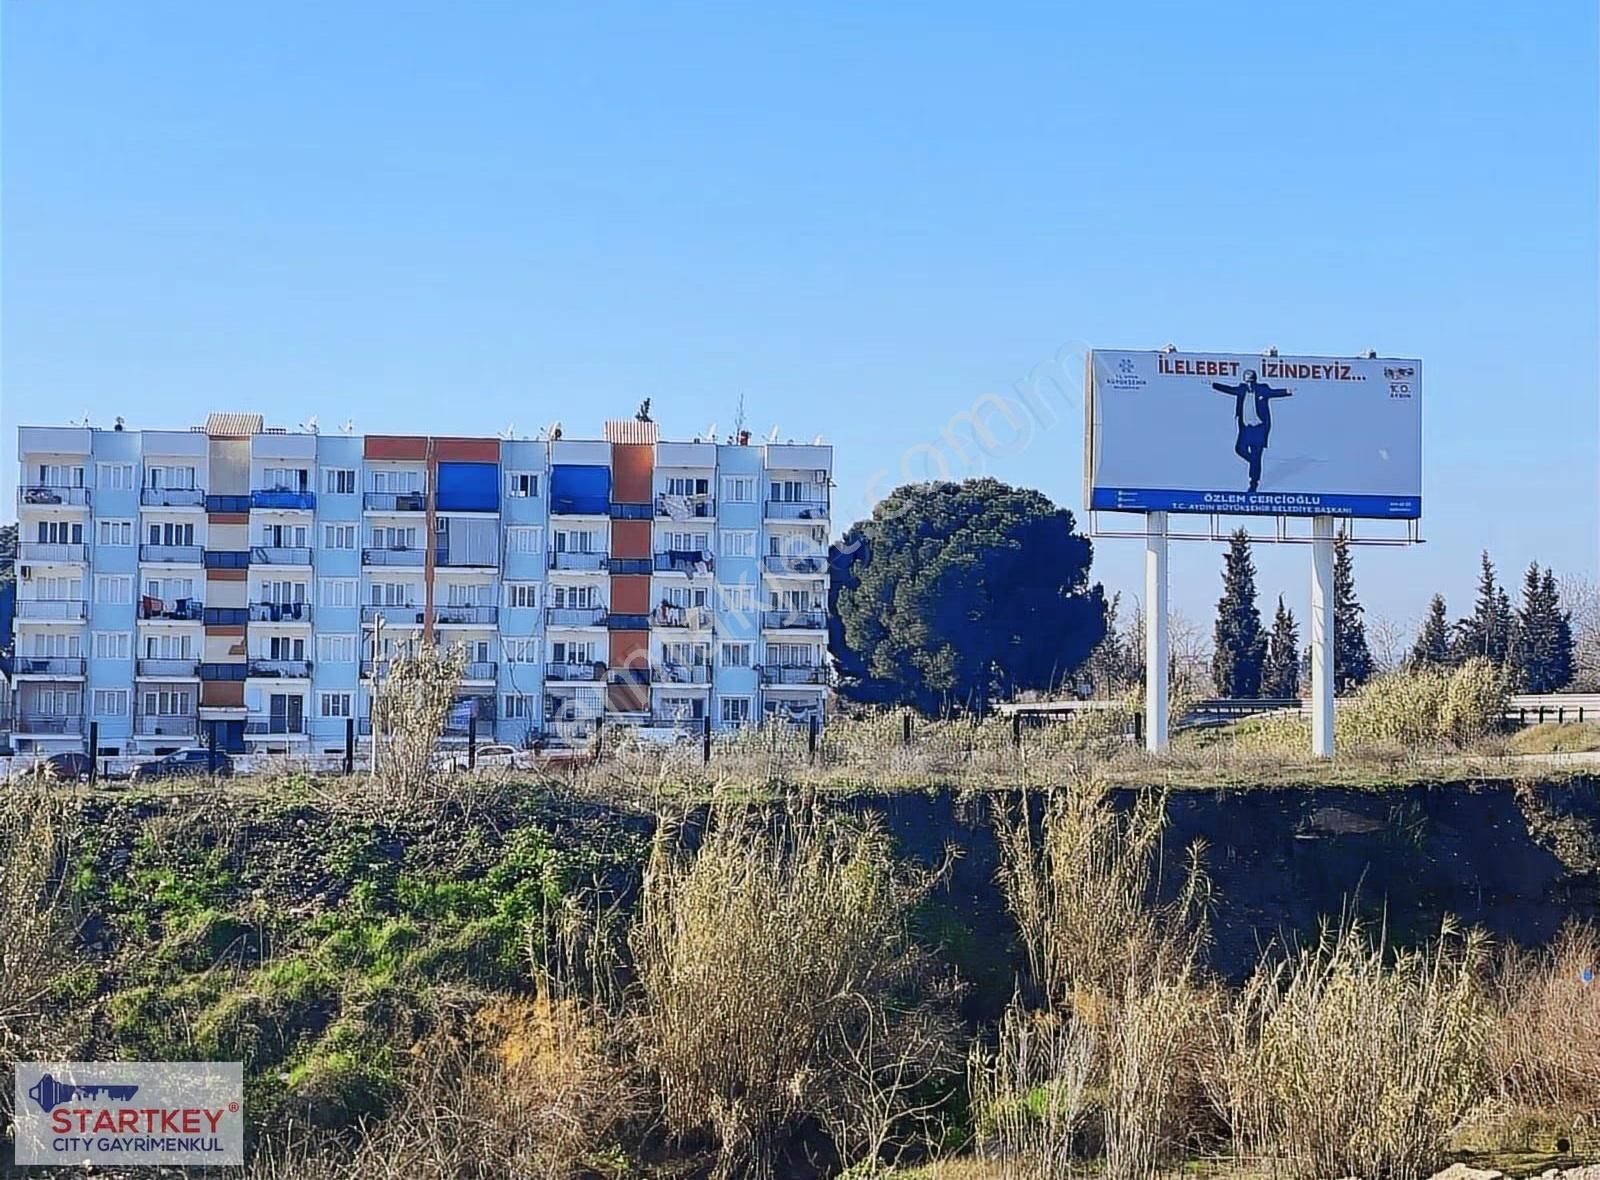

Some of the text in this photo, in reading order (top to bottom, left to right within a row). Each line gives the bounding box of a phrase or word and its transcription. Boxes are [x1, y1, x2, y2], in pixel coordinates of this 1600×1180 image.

[1159, 354, 1240, 377] İLELEBET
[1261, 358, 1366, 381] İZİNDEYİZ...
[1203, 493, 1246, 504] ÖZLEM
